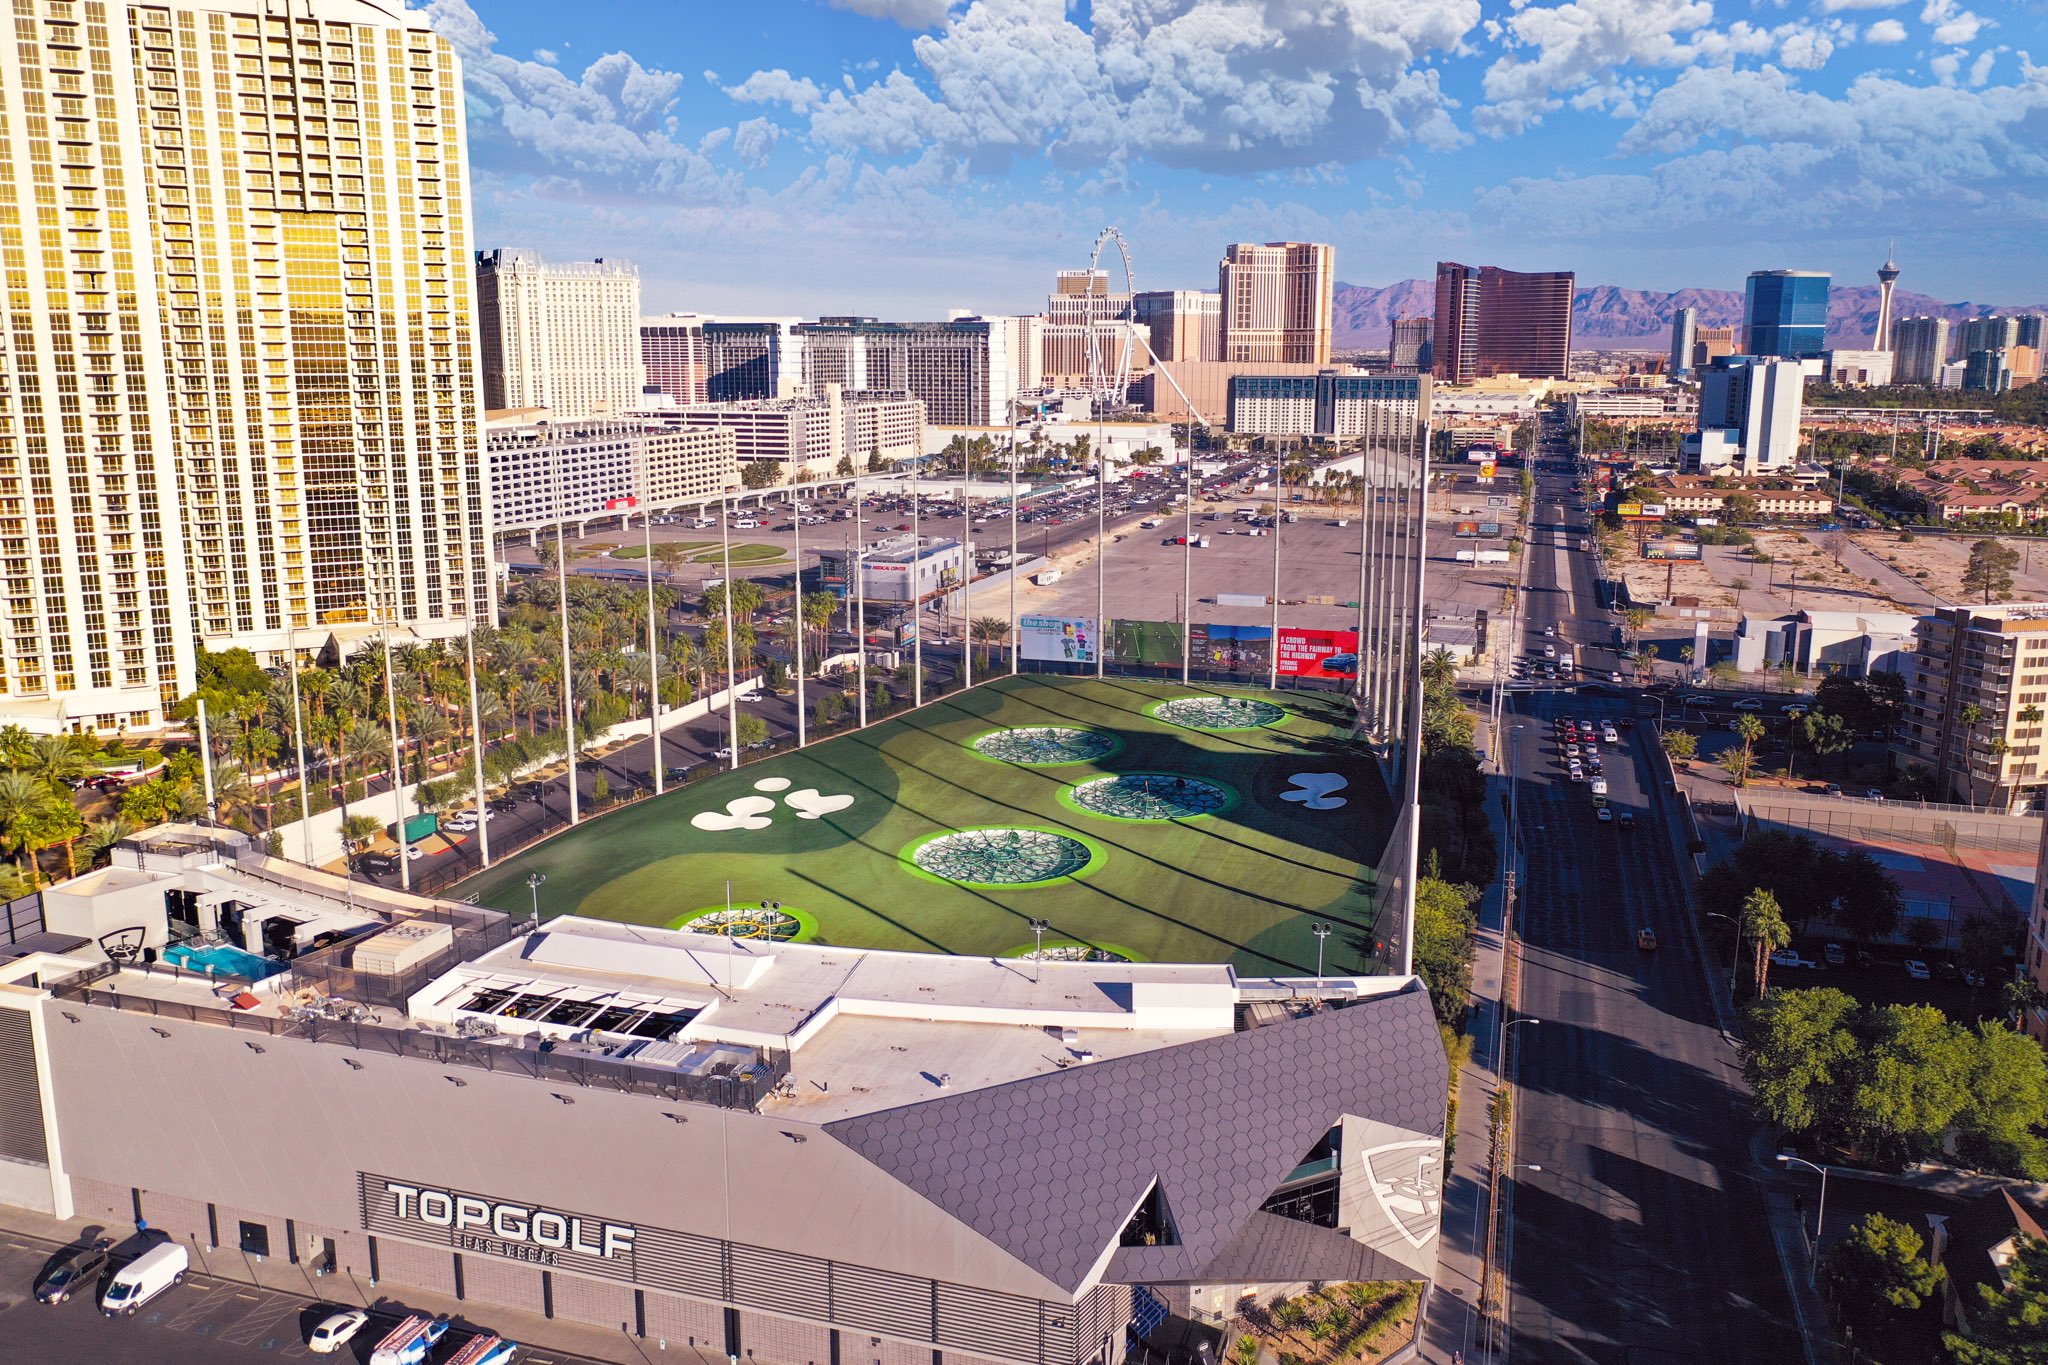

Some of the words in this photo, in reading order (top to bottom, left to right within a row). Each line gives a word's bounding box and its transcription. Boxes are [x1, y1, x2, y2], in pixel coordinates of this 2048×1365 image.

[1023, 619, 1038, 627] the
[1039, 619, 1060, 628] shop
[1280, 636, 1284, 644] A
[1291, 652, 1317, 660] HIGHWAY
[387, 1183, 637, 1259] TOPGOLF
[462, 1234, 493, 1254] LAS
[505, 1244, 560, 1266] VEGAS
